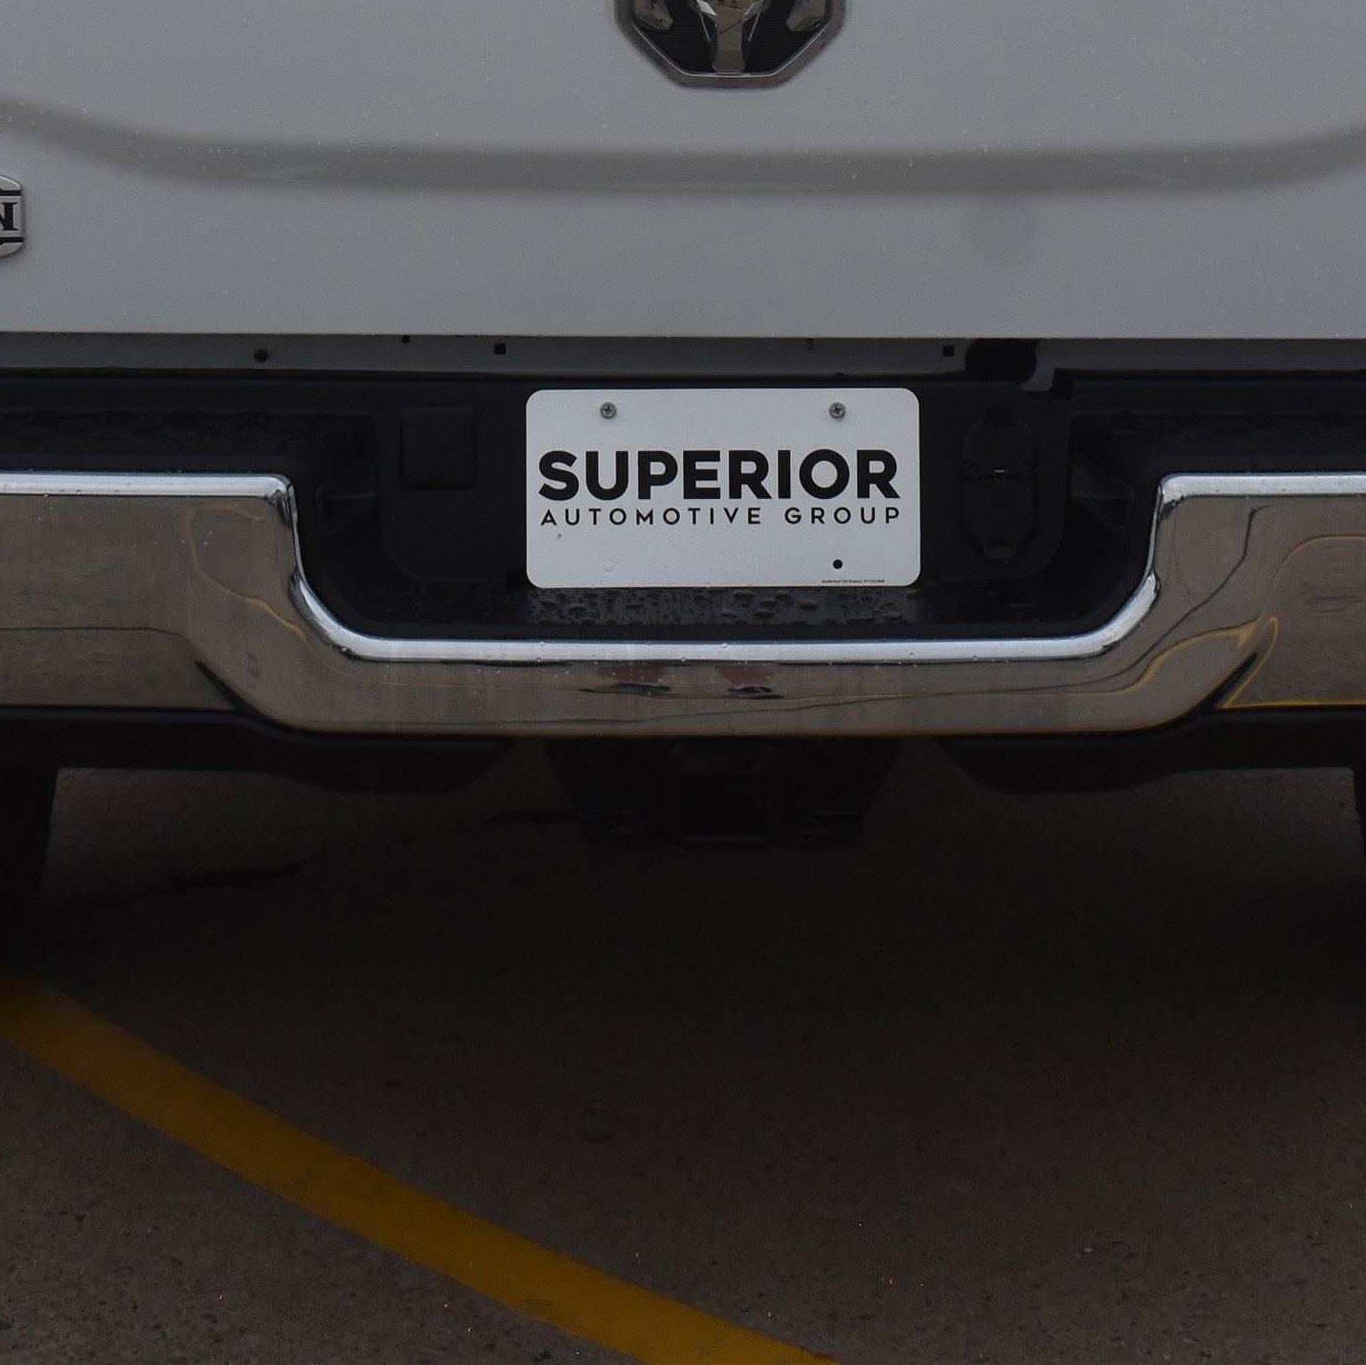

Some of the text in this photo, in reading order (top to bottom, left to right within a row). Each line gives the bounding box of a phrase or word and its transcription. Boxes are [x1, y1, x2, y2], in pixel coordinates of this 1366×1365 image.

[538, 448, 901, 501] SUPERIOR
[540, 506, 901, 526] AUTOMOTIVE GROUP
